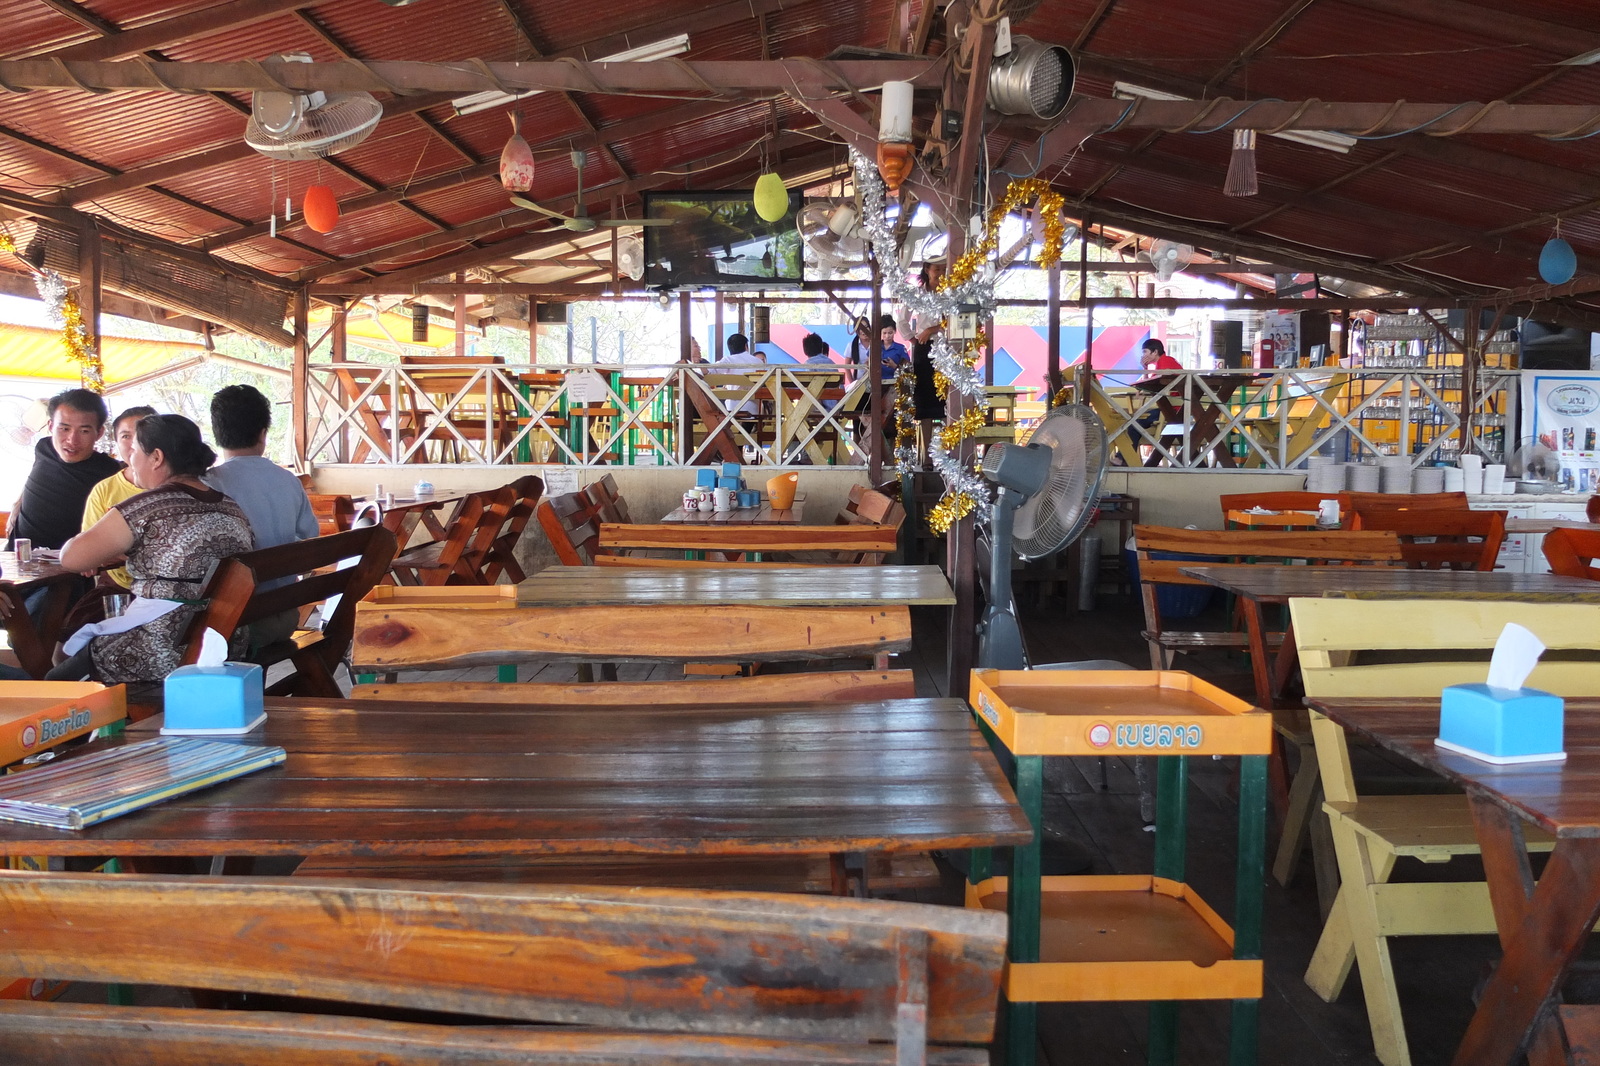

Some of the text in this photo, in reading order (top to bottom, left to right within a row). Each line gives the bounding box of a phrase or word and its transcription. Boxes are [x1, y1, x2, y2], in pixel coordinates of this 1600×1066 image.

[40, 709, 91, 744] Beerlao
[1116, 723, 1202, 748] ເບຍລາວ
